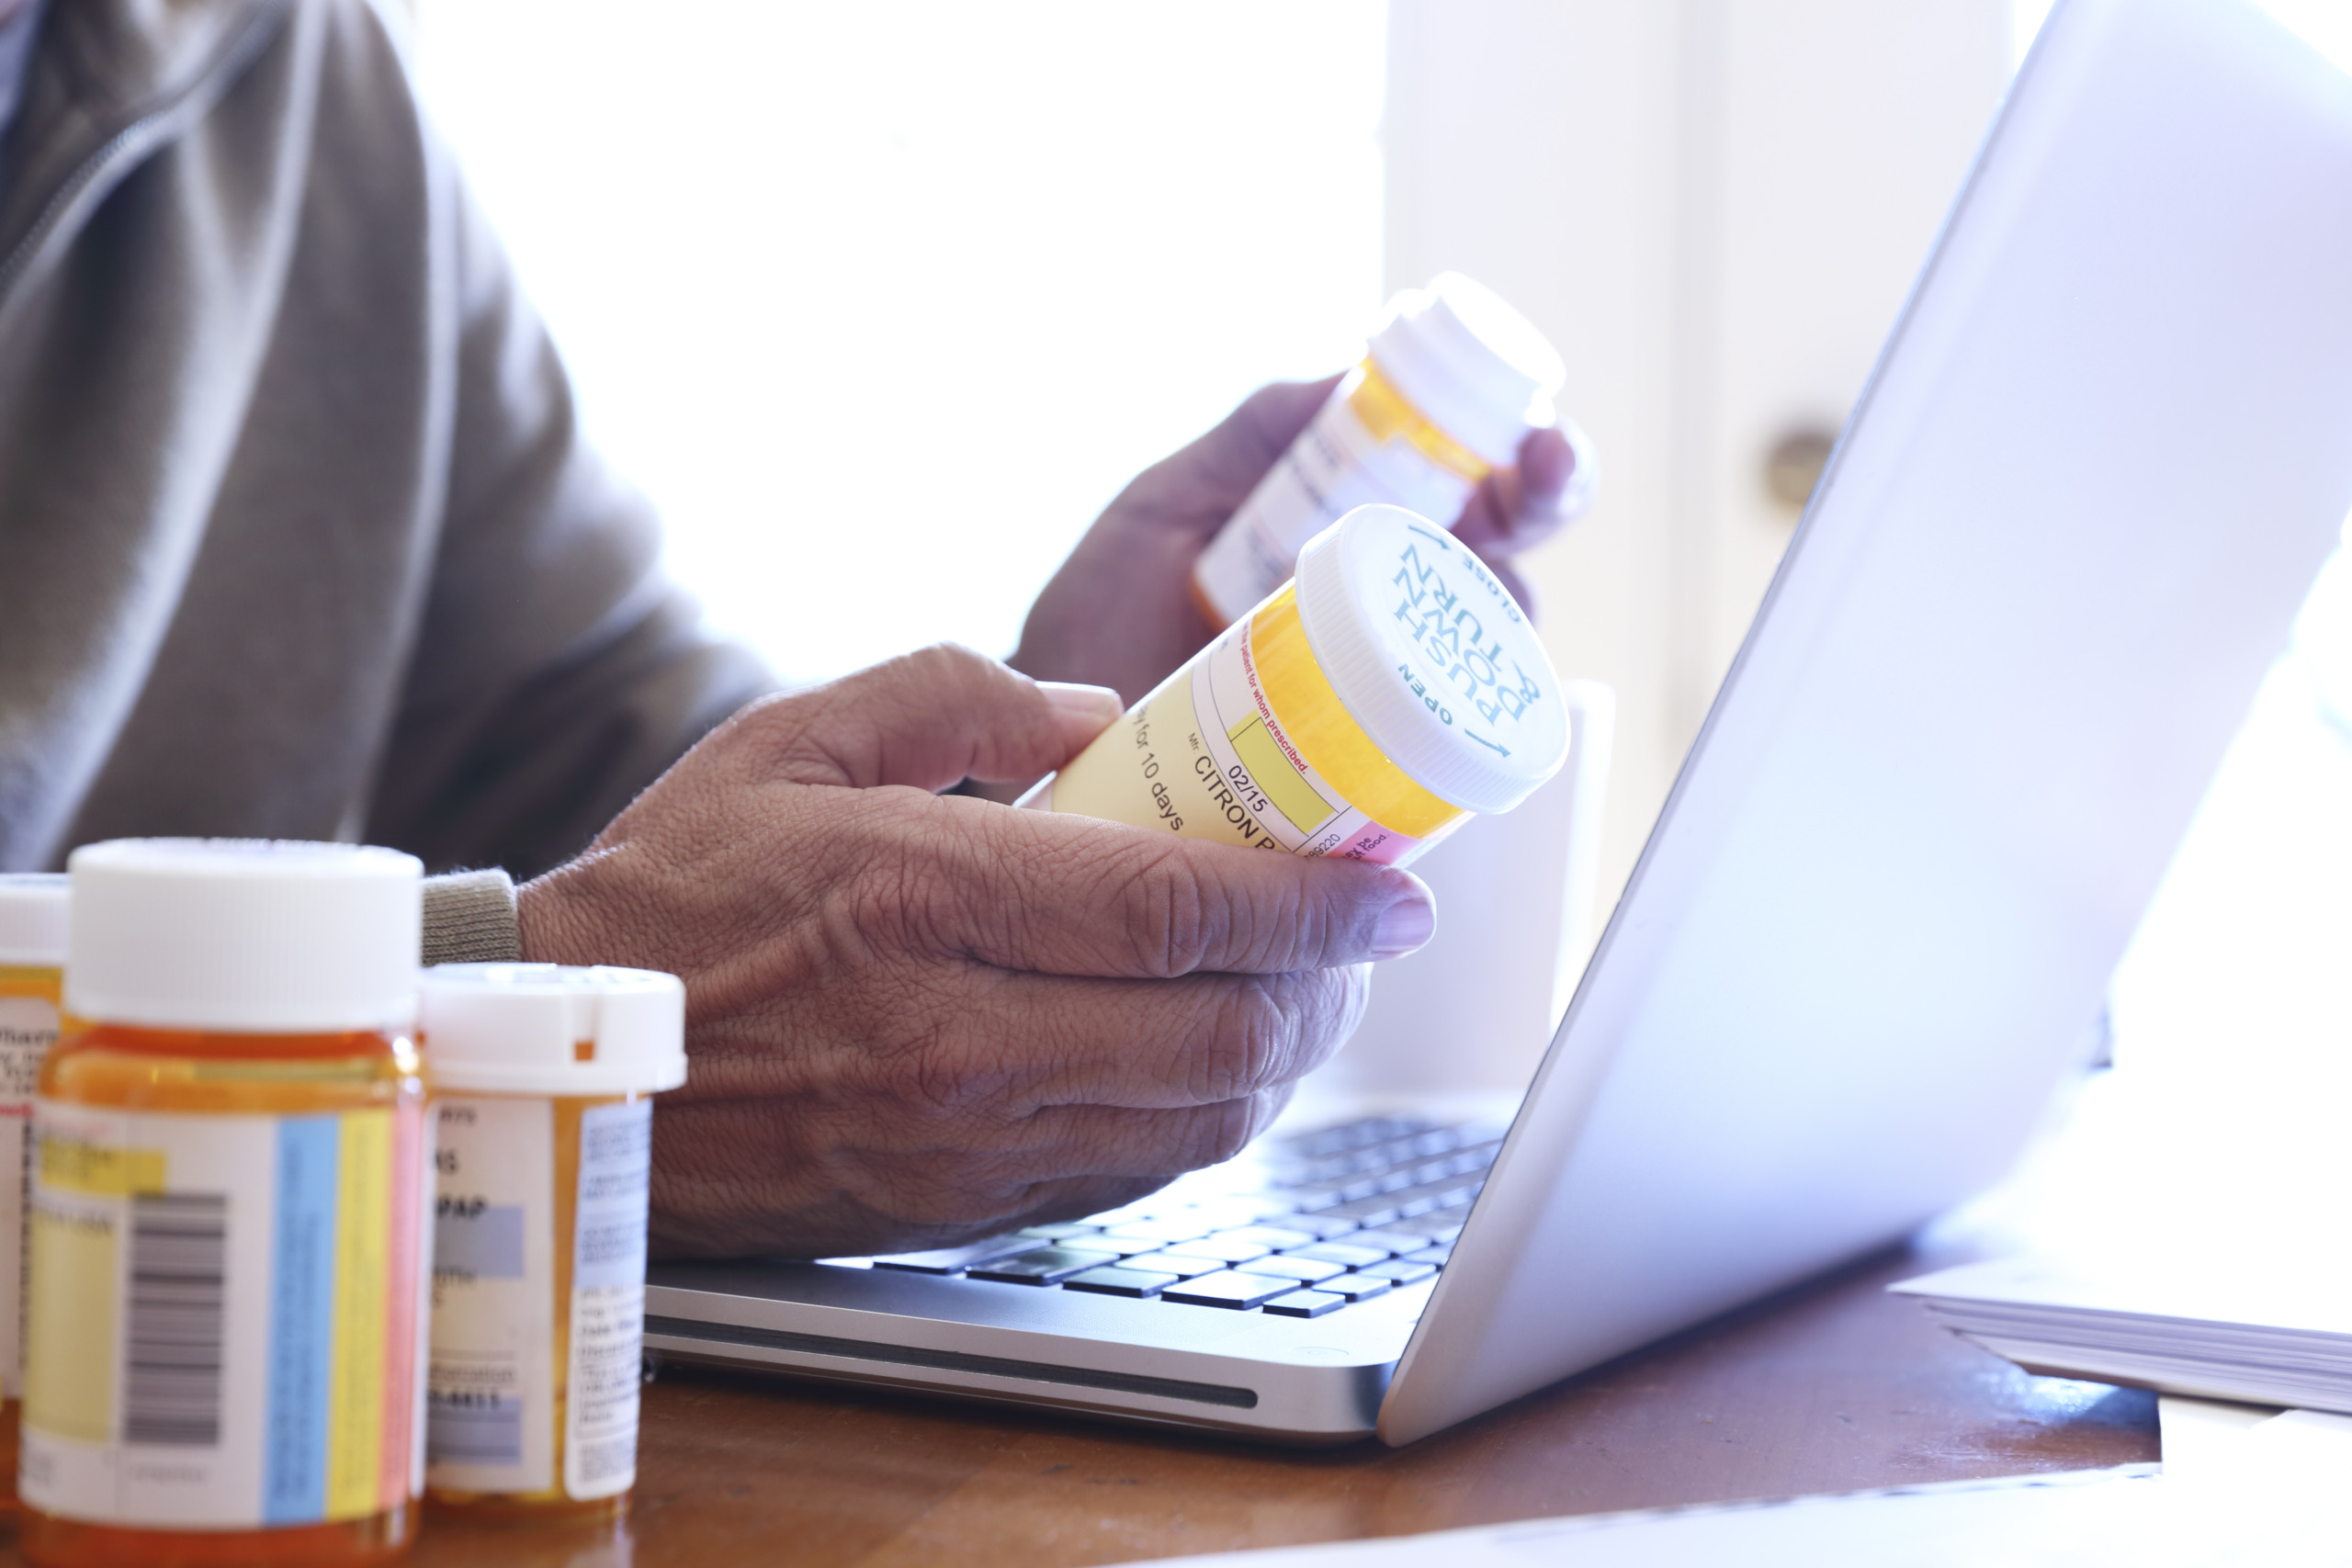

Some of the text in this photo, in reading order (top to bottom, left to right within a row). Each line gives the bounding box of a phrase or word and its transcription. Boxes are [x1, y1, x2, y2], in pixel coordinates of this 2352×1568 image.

[1462, 552, 1522, 624] CLOSE
[1391, 566, 1527, 723] DOWN
[1400, 543, 1542, 705] & TURN
[1239, 644, 1253, 675] patient
[1248, 672, 1258, 689] for
[1393, 598, 1504, 726] PUSH
[1252, 687, 1272, 719] whom
[1396, 662, 1453, 726] OPEN
[1136, 723, 1149, 750] for
[1265, 719, 1308, 775] prescribed.
[1141, 752, 1159, 779] 10
[1228, 764, 1269, 813] 02/15
[1151, 782, 1184, 831] days
[1194, 755, 1260, 840] CITRON
[1356, 837, 1373, 847] be
